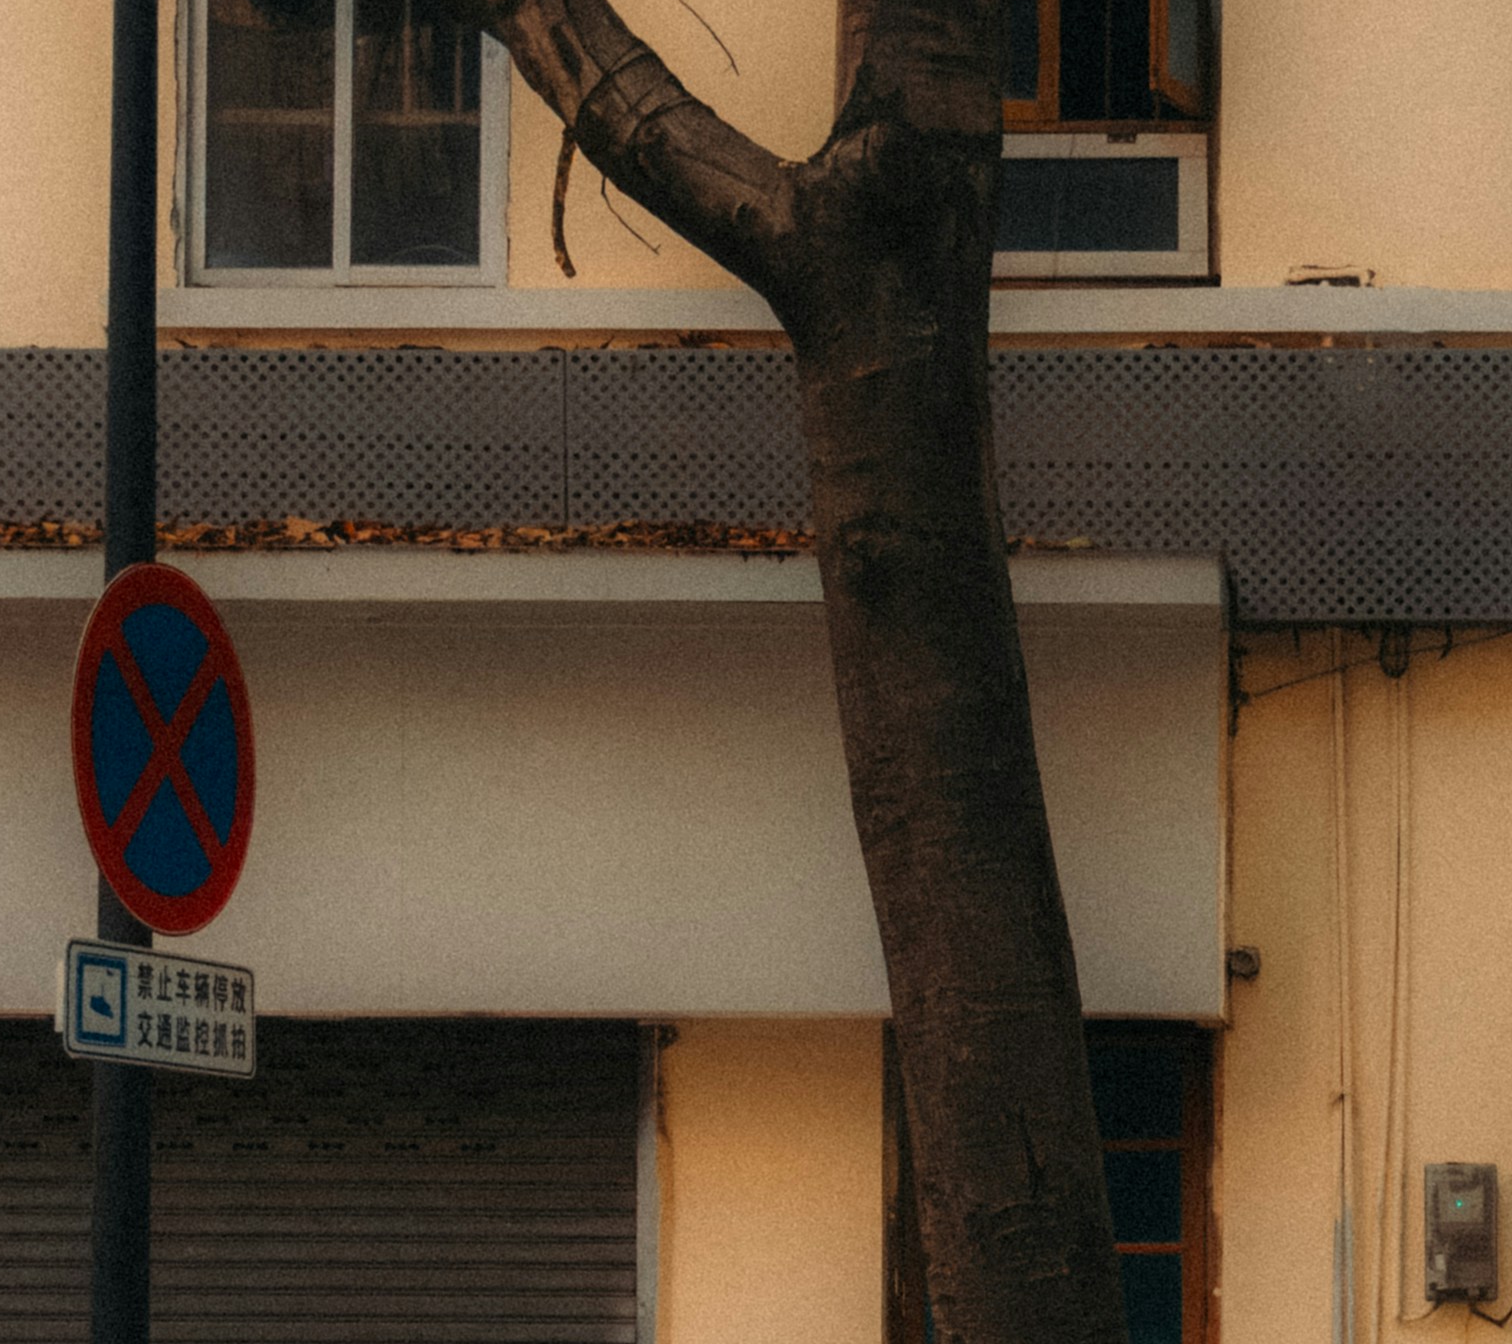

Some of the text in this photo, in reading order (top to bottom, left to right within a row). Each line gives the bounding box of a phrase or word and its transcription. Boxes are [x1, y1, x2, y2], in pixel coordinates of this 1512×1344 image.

[137, 962, 246, 1014] 禁止车辆停放
